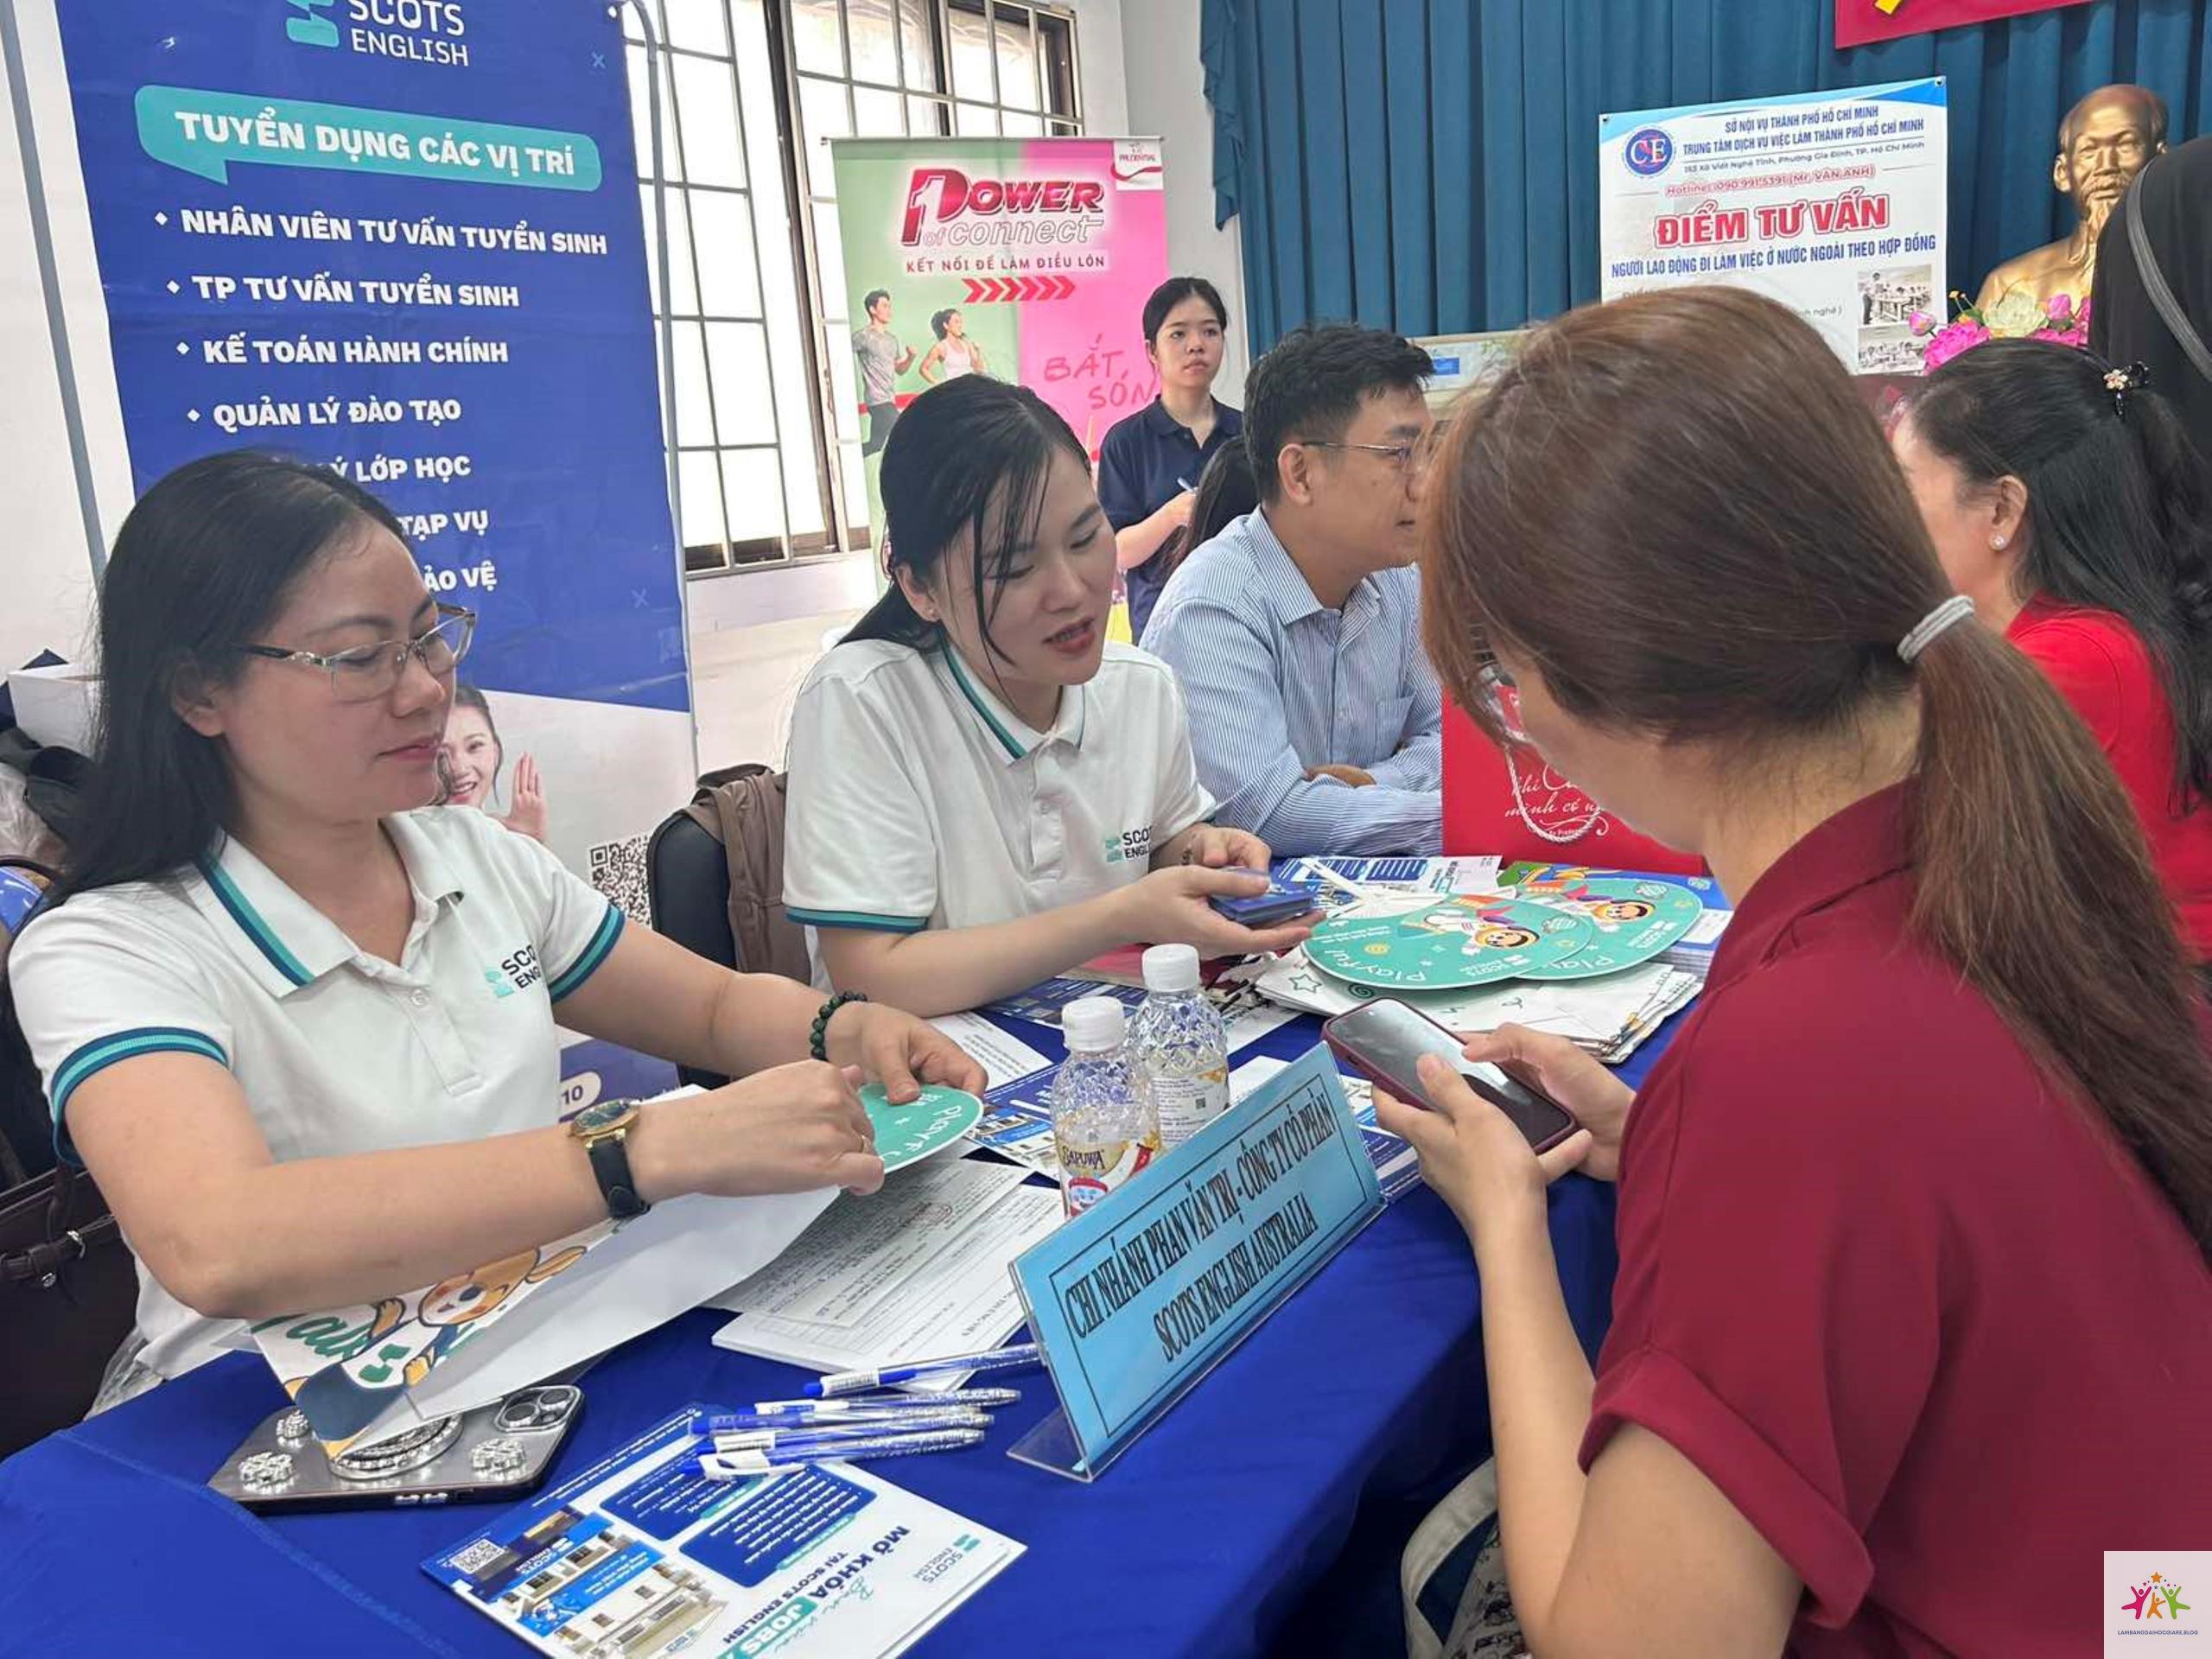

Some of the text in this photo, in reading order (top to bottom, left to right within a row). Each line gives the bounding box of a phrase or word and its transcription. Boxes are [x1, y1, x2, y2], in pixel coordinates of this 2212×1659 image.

[350, 0, 465, 36] SCOTS
[351, 28, 469, 67] ENGLISH
[1854, 105, 1878, 118] MINH
[175, 106, 575, 177] TUYỂN DỤNG CÁC VỊ TRÍ
[1683, 143, 1711, 156] TRUNG
[1899, 118, 1923, 132] MINH
[901, 168, 1105, 246] POWER
[1656, 187, 1889, 247] ĐIỂM TƯ VẤN
[181, 206, 607, 255] NHÂN VIÊN TƯ VẤN TUYỂN SINH
[949, 215, 1105, 246] connect
[1647, 259, 1665, 275] LAO
[1669, 255, 1696, 276] ĐỘNG
[1700, 257, 1711, 271] ĐI
[1713, 252, 1736, 270] LÀM
[1739, 251, 1764, 271] VIỆC
[1777, 245, 1807, 265] NƯỚC
[1810, 243, 1845, 262] NGOÀI
[1848, 241, 1875, 257] THEO
[1879, 238, 1901, 257] HỢP
[1904, 232, 1936, 252] ĐỒNG
[193, 271, 520, 308] TP TƯ VẤN TUYỂN SINH
[204, 332, 509, 365] KẾ TOÁN HÀNH CHÍNH
[213, 395, 461, 433] QUẢN LÝ ĐÀO TẠO
[355, 454, 408, 483] LỚP
[415, 455, 471, 483] HỌC
[396, 510, 489, 541] TẠP VỤ
[424, 560, 497, 592] ẢO VỆ
[1065, 1274, 1105, 1338] CHI
[1090, 1233, 1156, 1318] NHÁNH
[1142, 1206, 1190, 1276] PHAN
[1179, 1179, 1218, 1244] VĂN
[1205, 1167, 1244, 1224] TRỊ
[1236, 1138, 1278, 1200] CÔNG
[1266, 1125, 1294, 1175] TY
[1283, 1103, 1308, 1162] CỔ
[1297, 1086, 1336, 1150] PHẦN
[1153, 1191, 1319, 1363] SCOTS ENGLISH AUSTRALIA
[823, 1551, 849, 1567] TẠI
[871, 1525, 911, 1555] MỞ
[781, 1567, 826, 1599] SCOTS
[807, 1553, 874, 1599] KHÓA
[920, 1550, 965, 1583] SCOTS
[721, 1599, 783, 1644] ENGLISH
[742, 1602, 807, 1655] JOBS
